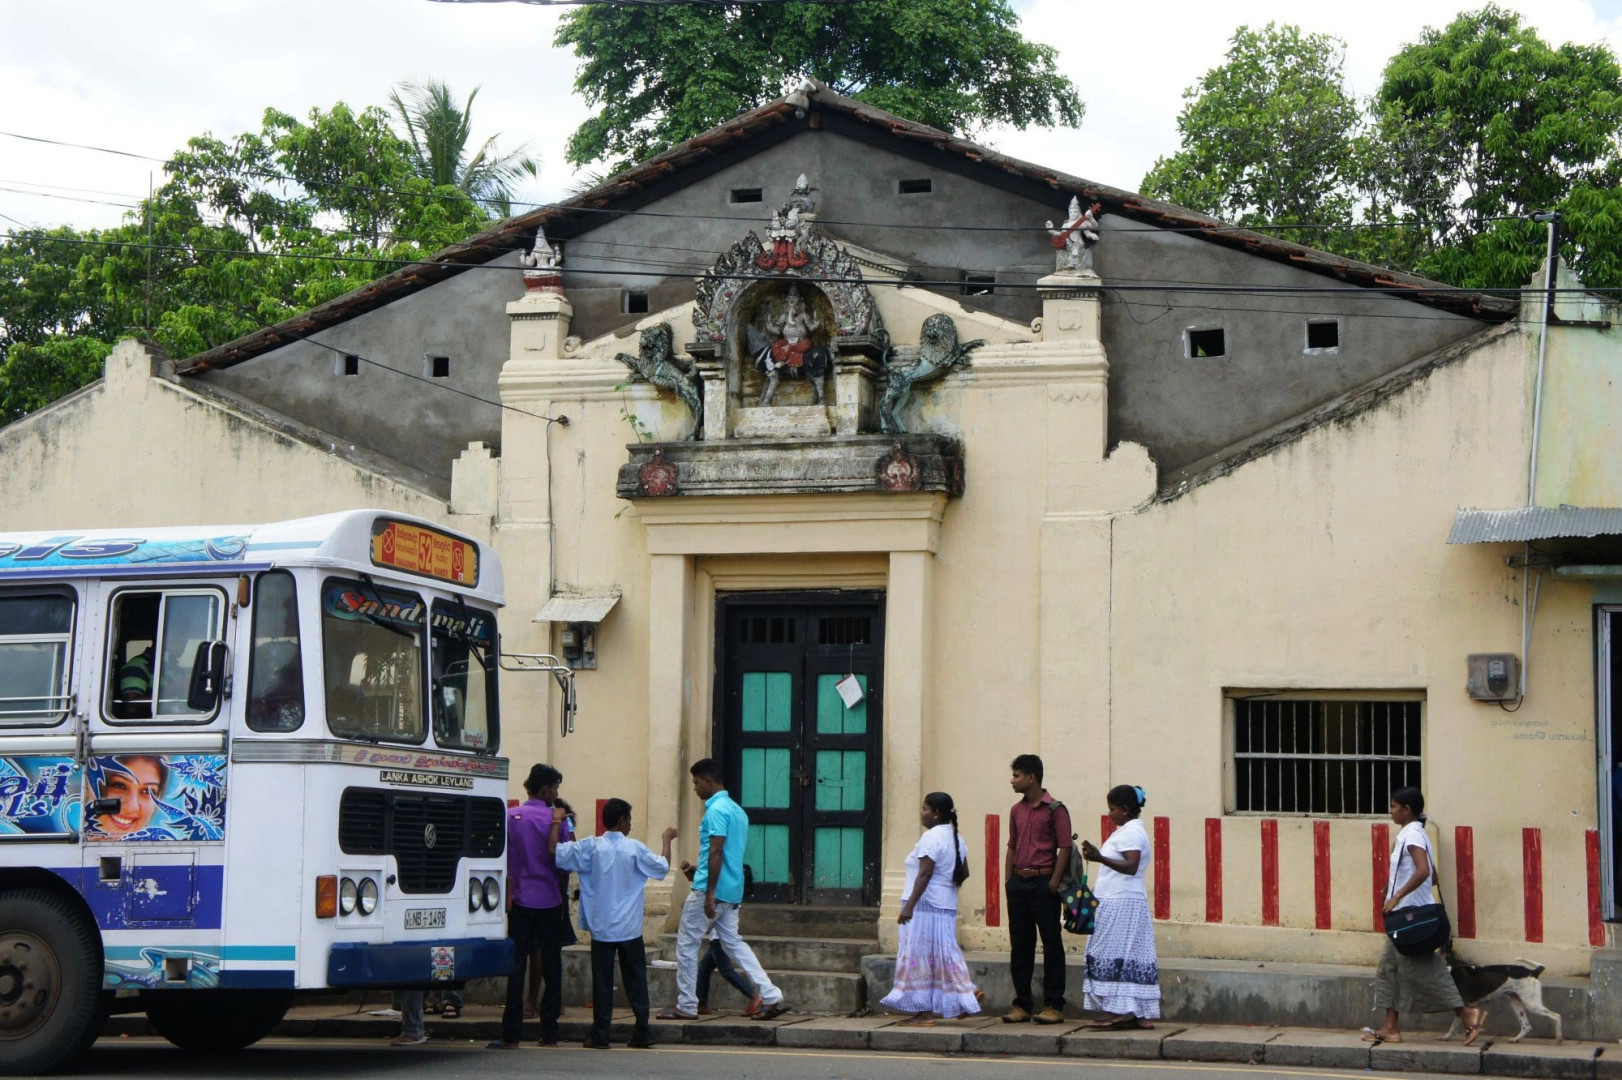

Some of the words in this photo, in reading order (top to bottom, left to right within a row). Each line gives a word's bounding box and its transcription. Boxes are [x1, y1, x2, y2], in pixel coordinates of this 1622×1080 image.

[419, 535, 432, 571] 52
[380, 771, 409, 782] LANKA
[411, 773, 439, 785] ASHOK
[441, 776, 474, 788] LEYLAND
